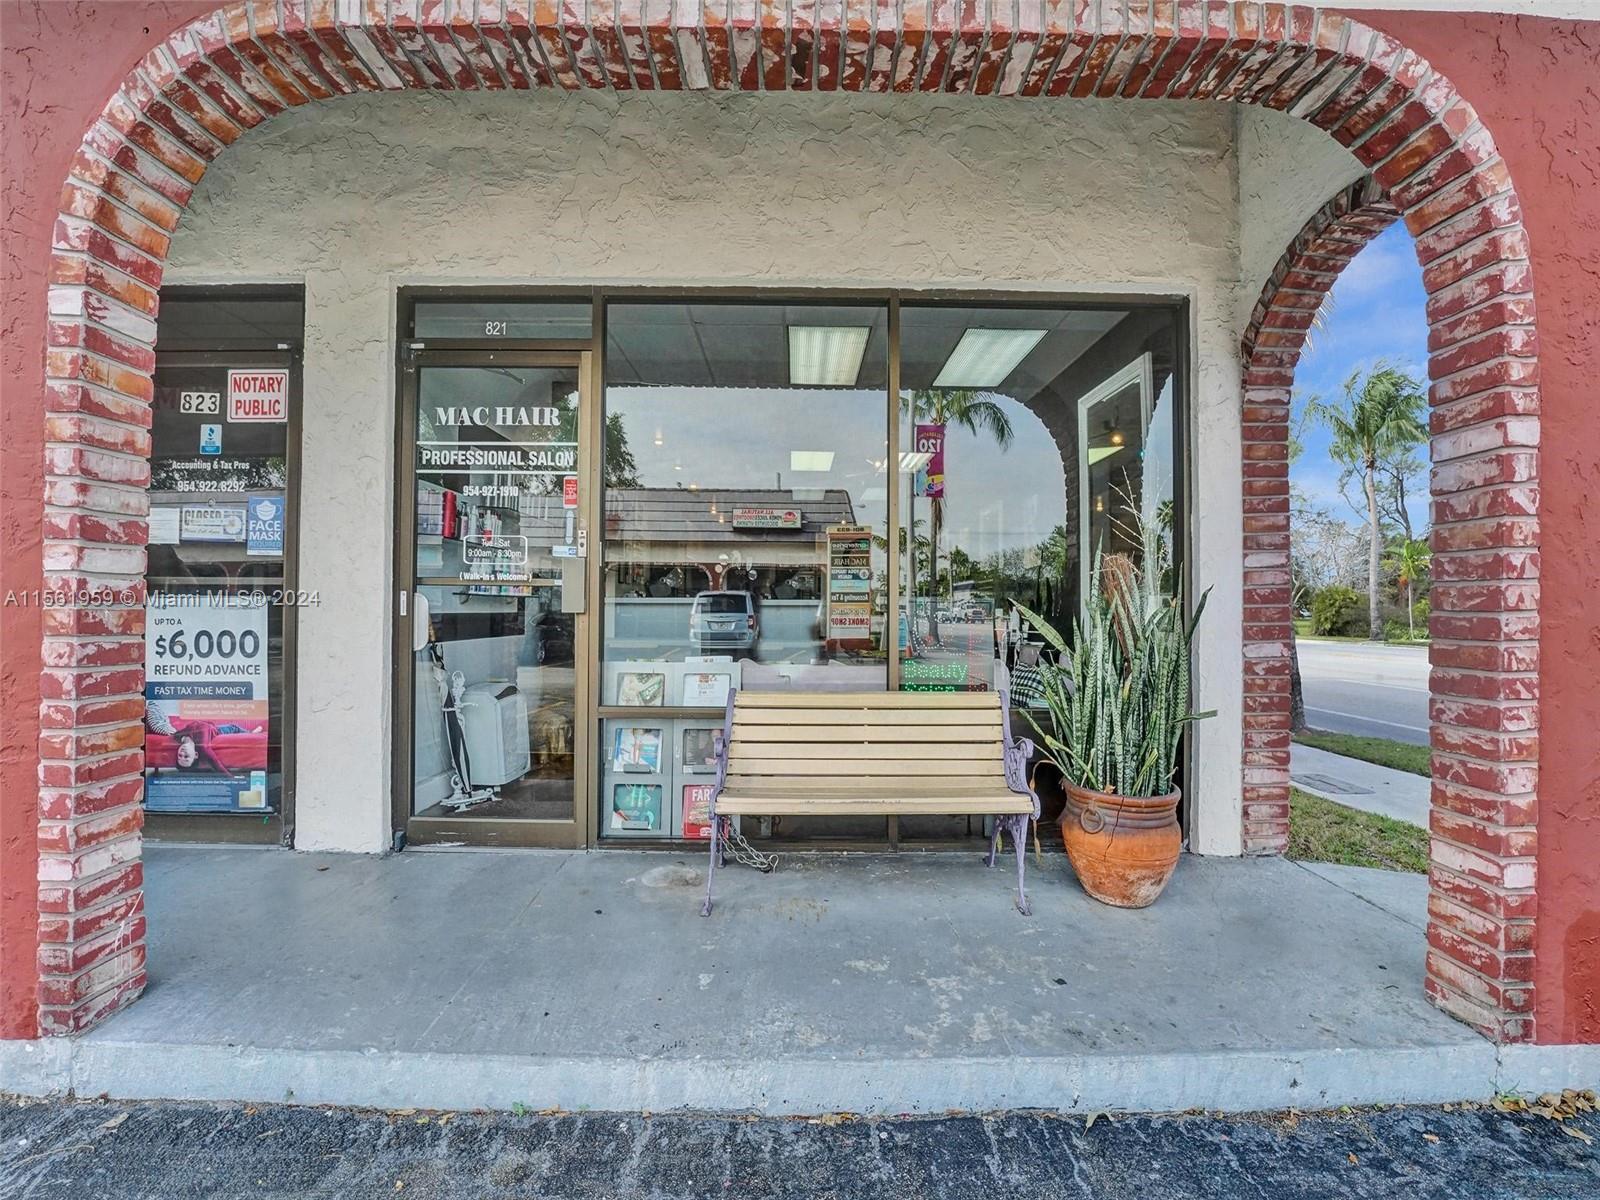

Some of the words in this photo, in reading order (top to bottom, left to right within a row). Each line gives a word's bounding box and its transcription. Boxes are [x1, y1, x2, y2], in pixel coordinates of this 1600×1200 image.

[485, 321, 507, 336] 821
[233, 376, 283, 393] NOTARY
[182, 393, 218, 413] 823
[235, 399, 281, 416] PUBLIC
[435, 406, 489, 426] MAC
[494, 406, 561, 426] HAIR
[421, 450, 525, 465] PROFESSIONAL
[529, 450, 573, 466] SALON
[172, 461, 211, 470] Accounting
[212, 461, 219, 469] &
[220, 461, 232, 469] Tax
[233, 461, 250, 469] Pros
[177, 480, 245, 492] 954.922.8292
[249, 520, 281, 531] FACE
[249, 531, 281, 541] MASK
[498, 539, 510, 547] Sat
[467, 548, 492, 557] 9:00am
[155, 629, 260, 661] $6,000
[154, 664, 202, 675] REFUND
[204, 664, 261, 675] ADVANCE
[905, 660, 968, 683] Beauty
[154, 686, 175, 695] FAST
[176, 686, 193, 695] TAX
[194, 686, 214, 695] TIME
[215, 686, 247, 695] MONEY
